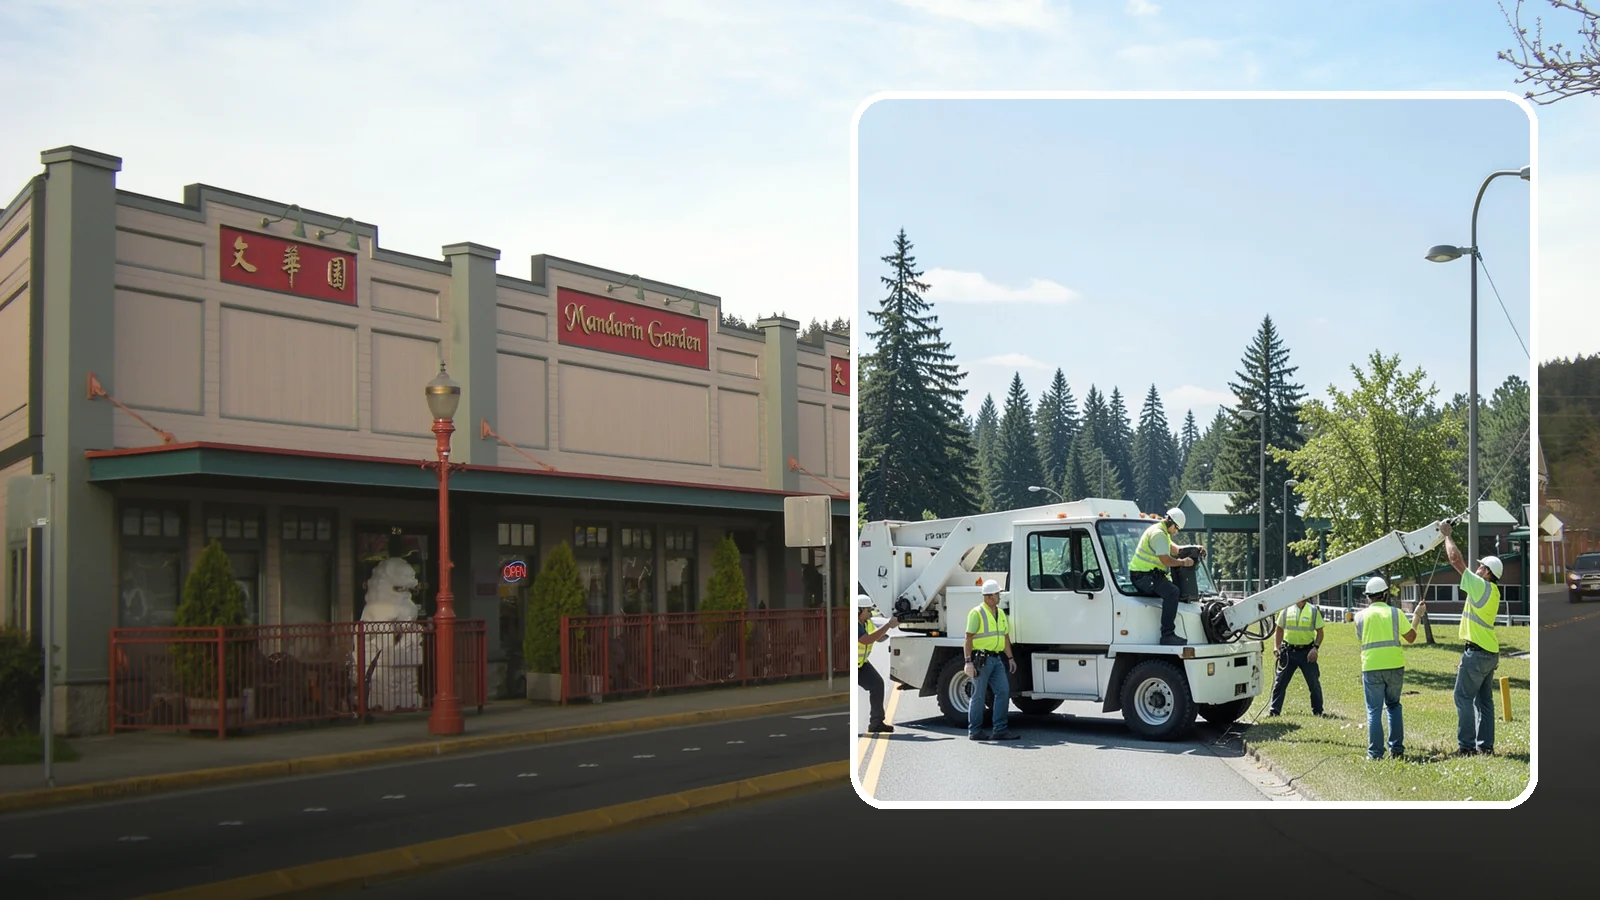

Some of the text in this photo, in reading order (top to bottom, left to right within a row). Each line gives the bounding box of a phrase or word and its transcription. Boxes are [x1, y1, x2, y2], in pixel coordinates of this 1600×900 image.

[231, 236, 346, 291] 文華園
[564, 302, 702, 352] Mandarin Garden
[503, 565, 527, 578] OPEN
